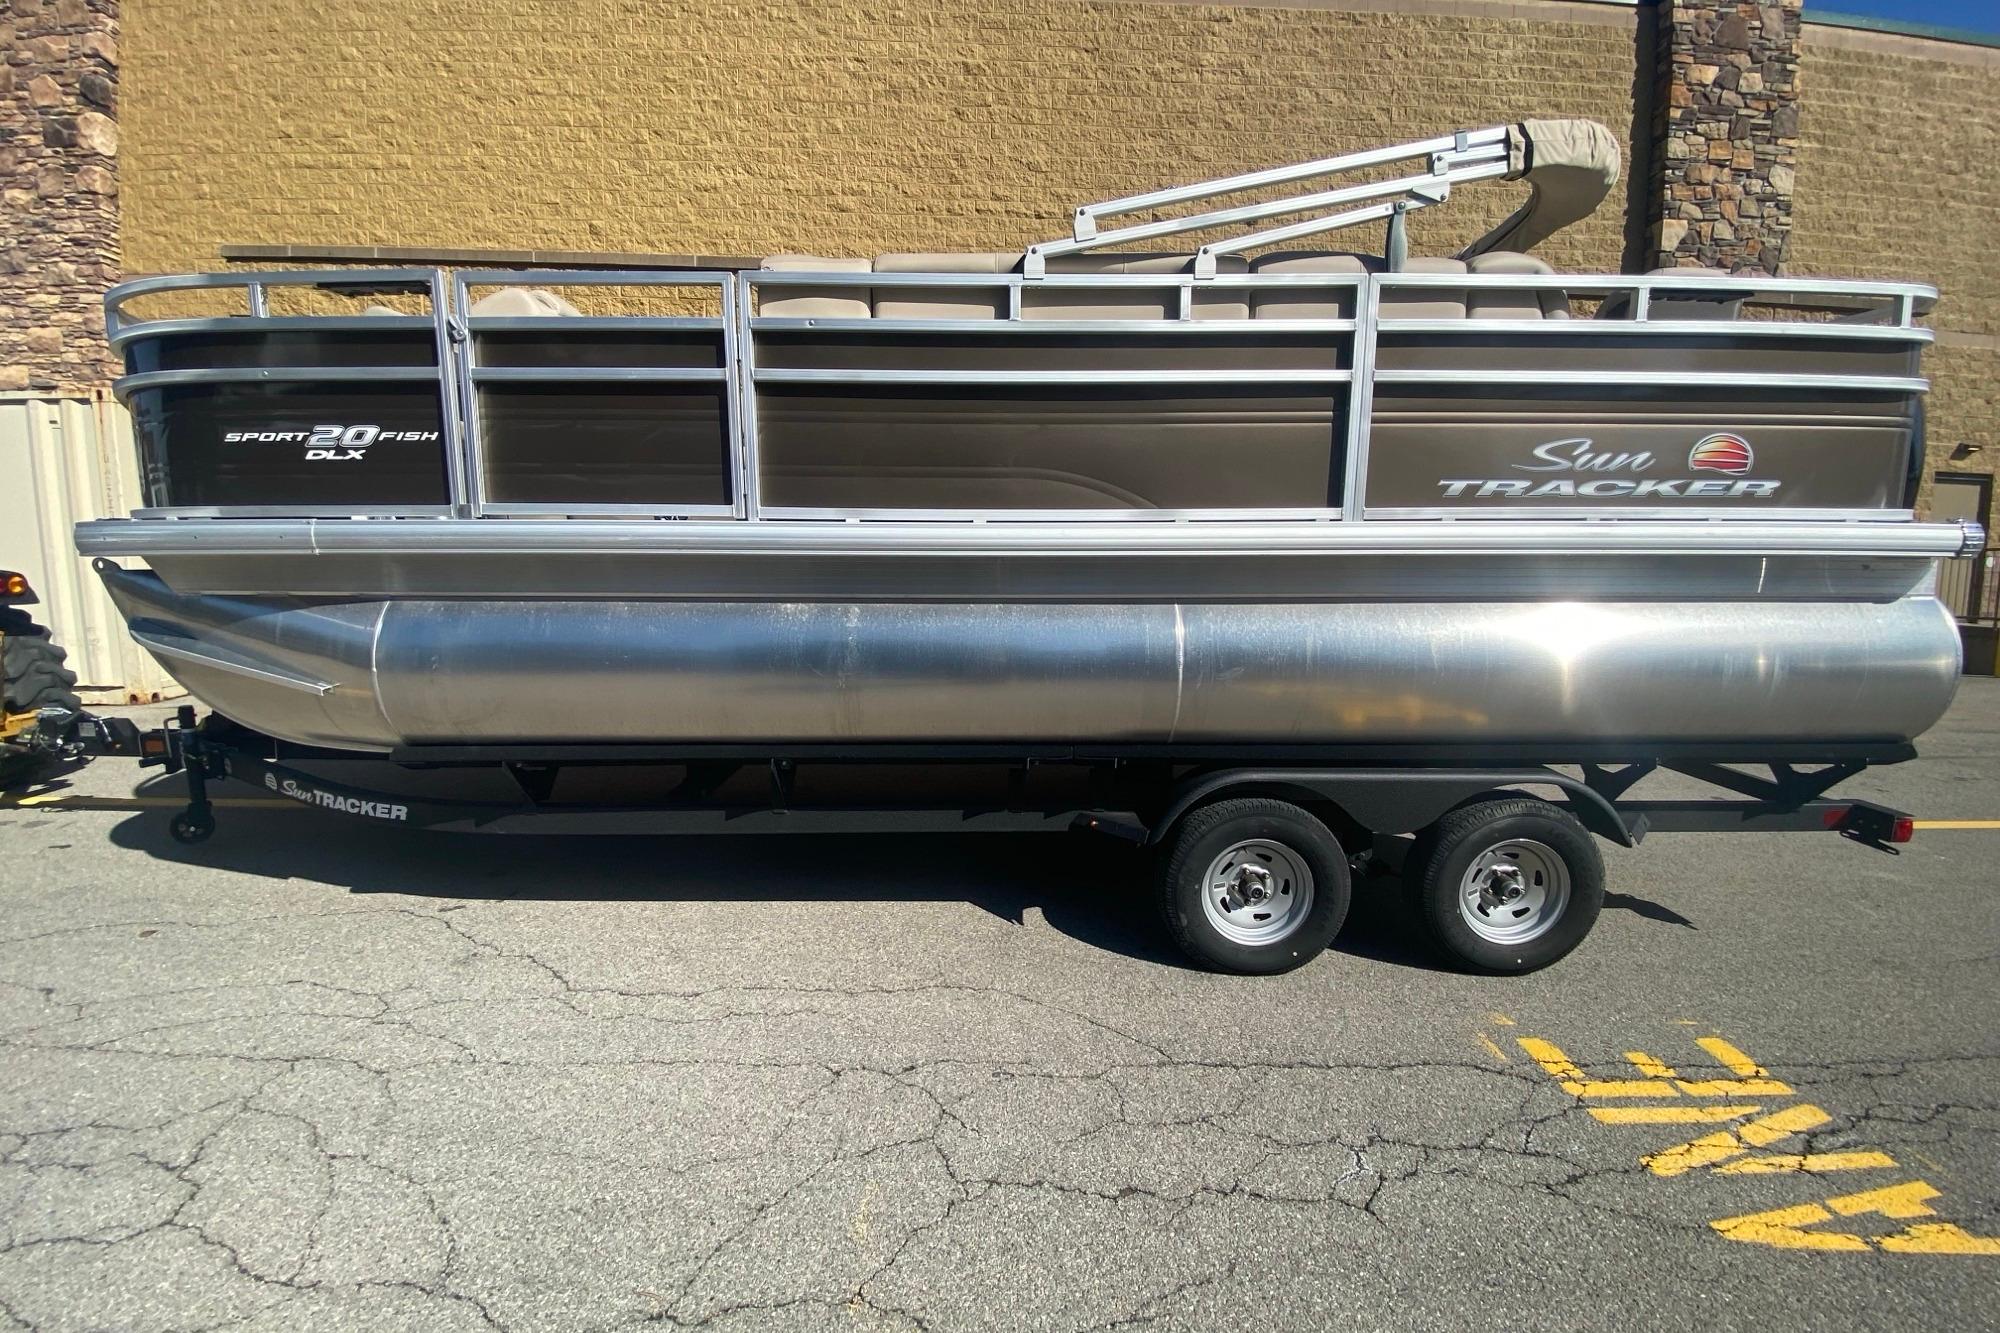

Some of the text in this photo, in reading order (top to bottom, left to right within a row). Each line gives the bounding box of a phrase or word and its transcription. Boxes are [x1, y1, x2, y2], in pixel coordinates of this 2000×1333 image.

[224, 424, 439, 448] SPORT 20 FISH
[305, 449, 366, 460] DLX
[1511, 437, 1657, 472] Sun
[1437, 479, 1782, 498] TRACKER
[280, 780, 408, 820] Sun TRACKER
